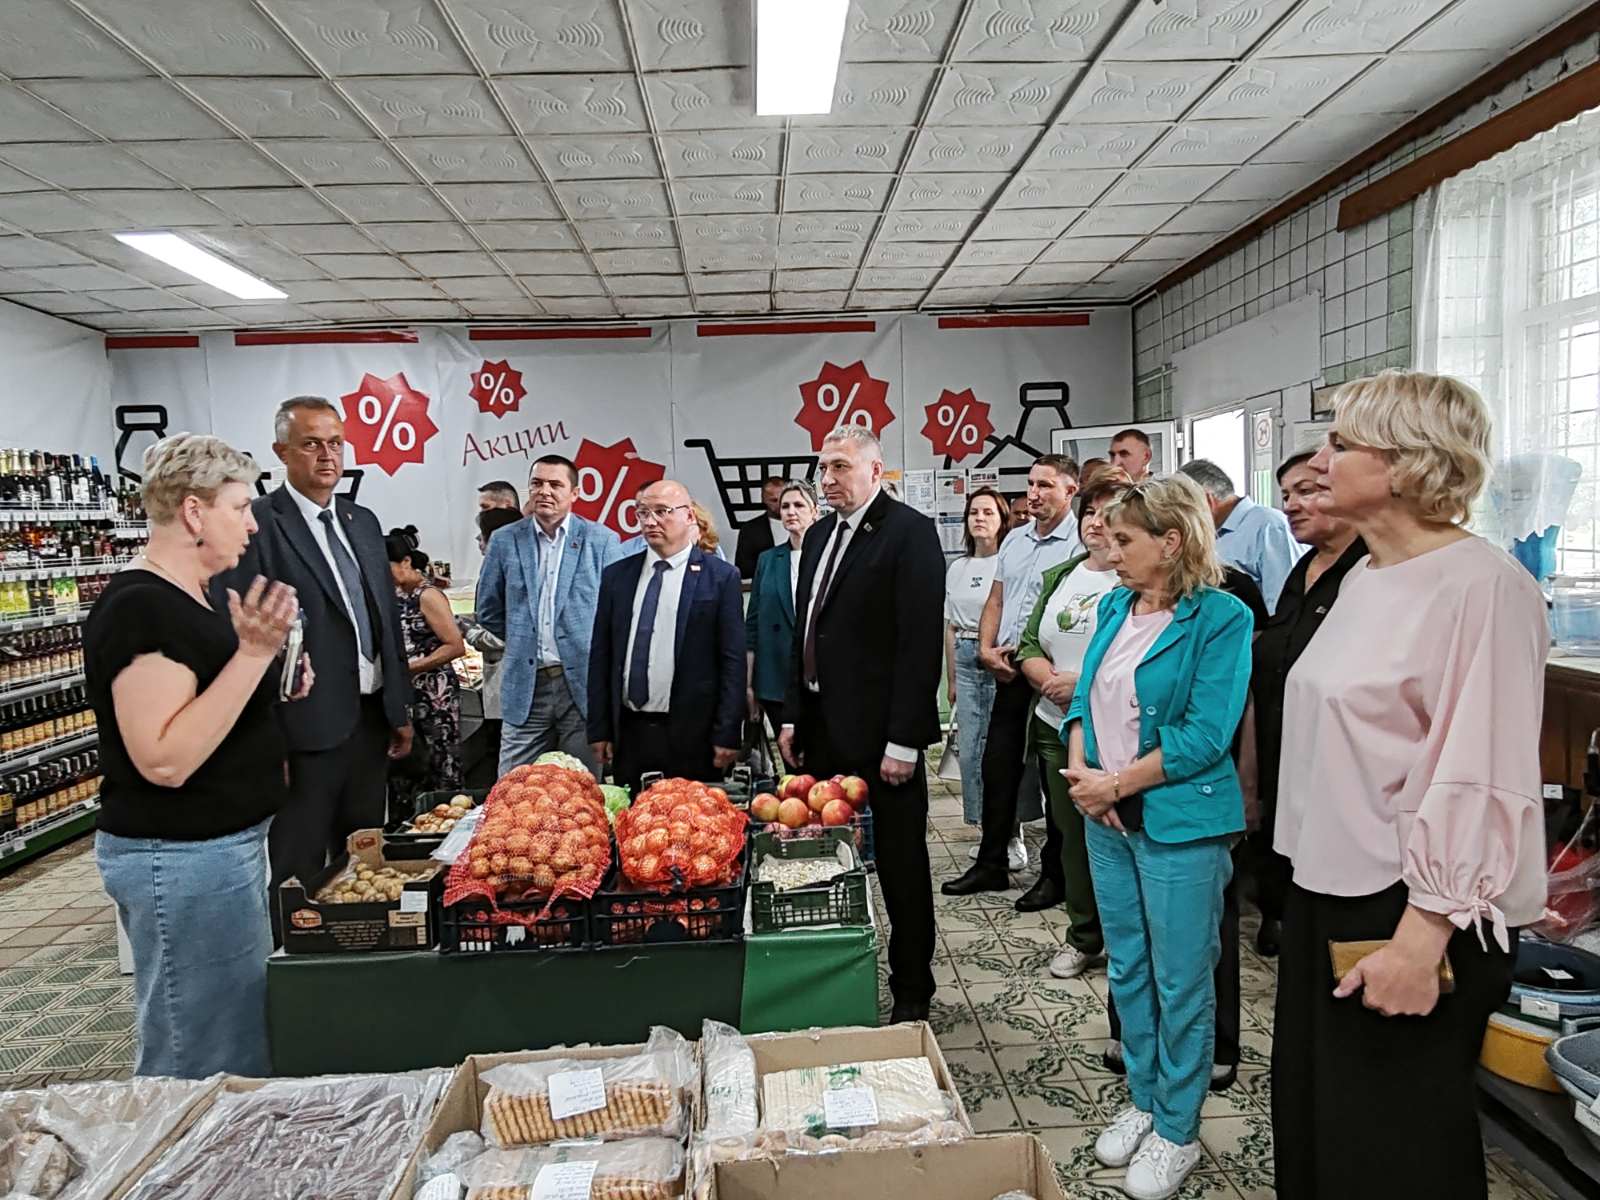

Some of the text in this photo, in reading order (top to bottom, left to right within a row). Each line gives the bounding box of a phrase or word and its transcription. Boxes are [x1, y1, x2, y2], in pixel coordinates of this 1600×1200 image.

[481, 373, 514, 405] %
[358, 395, 416, 452] %
[462, 420, 570, 467] Акции
[936, 404, 978, 446] %
